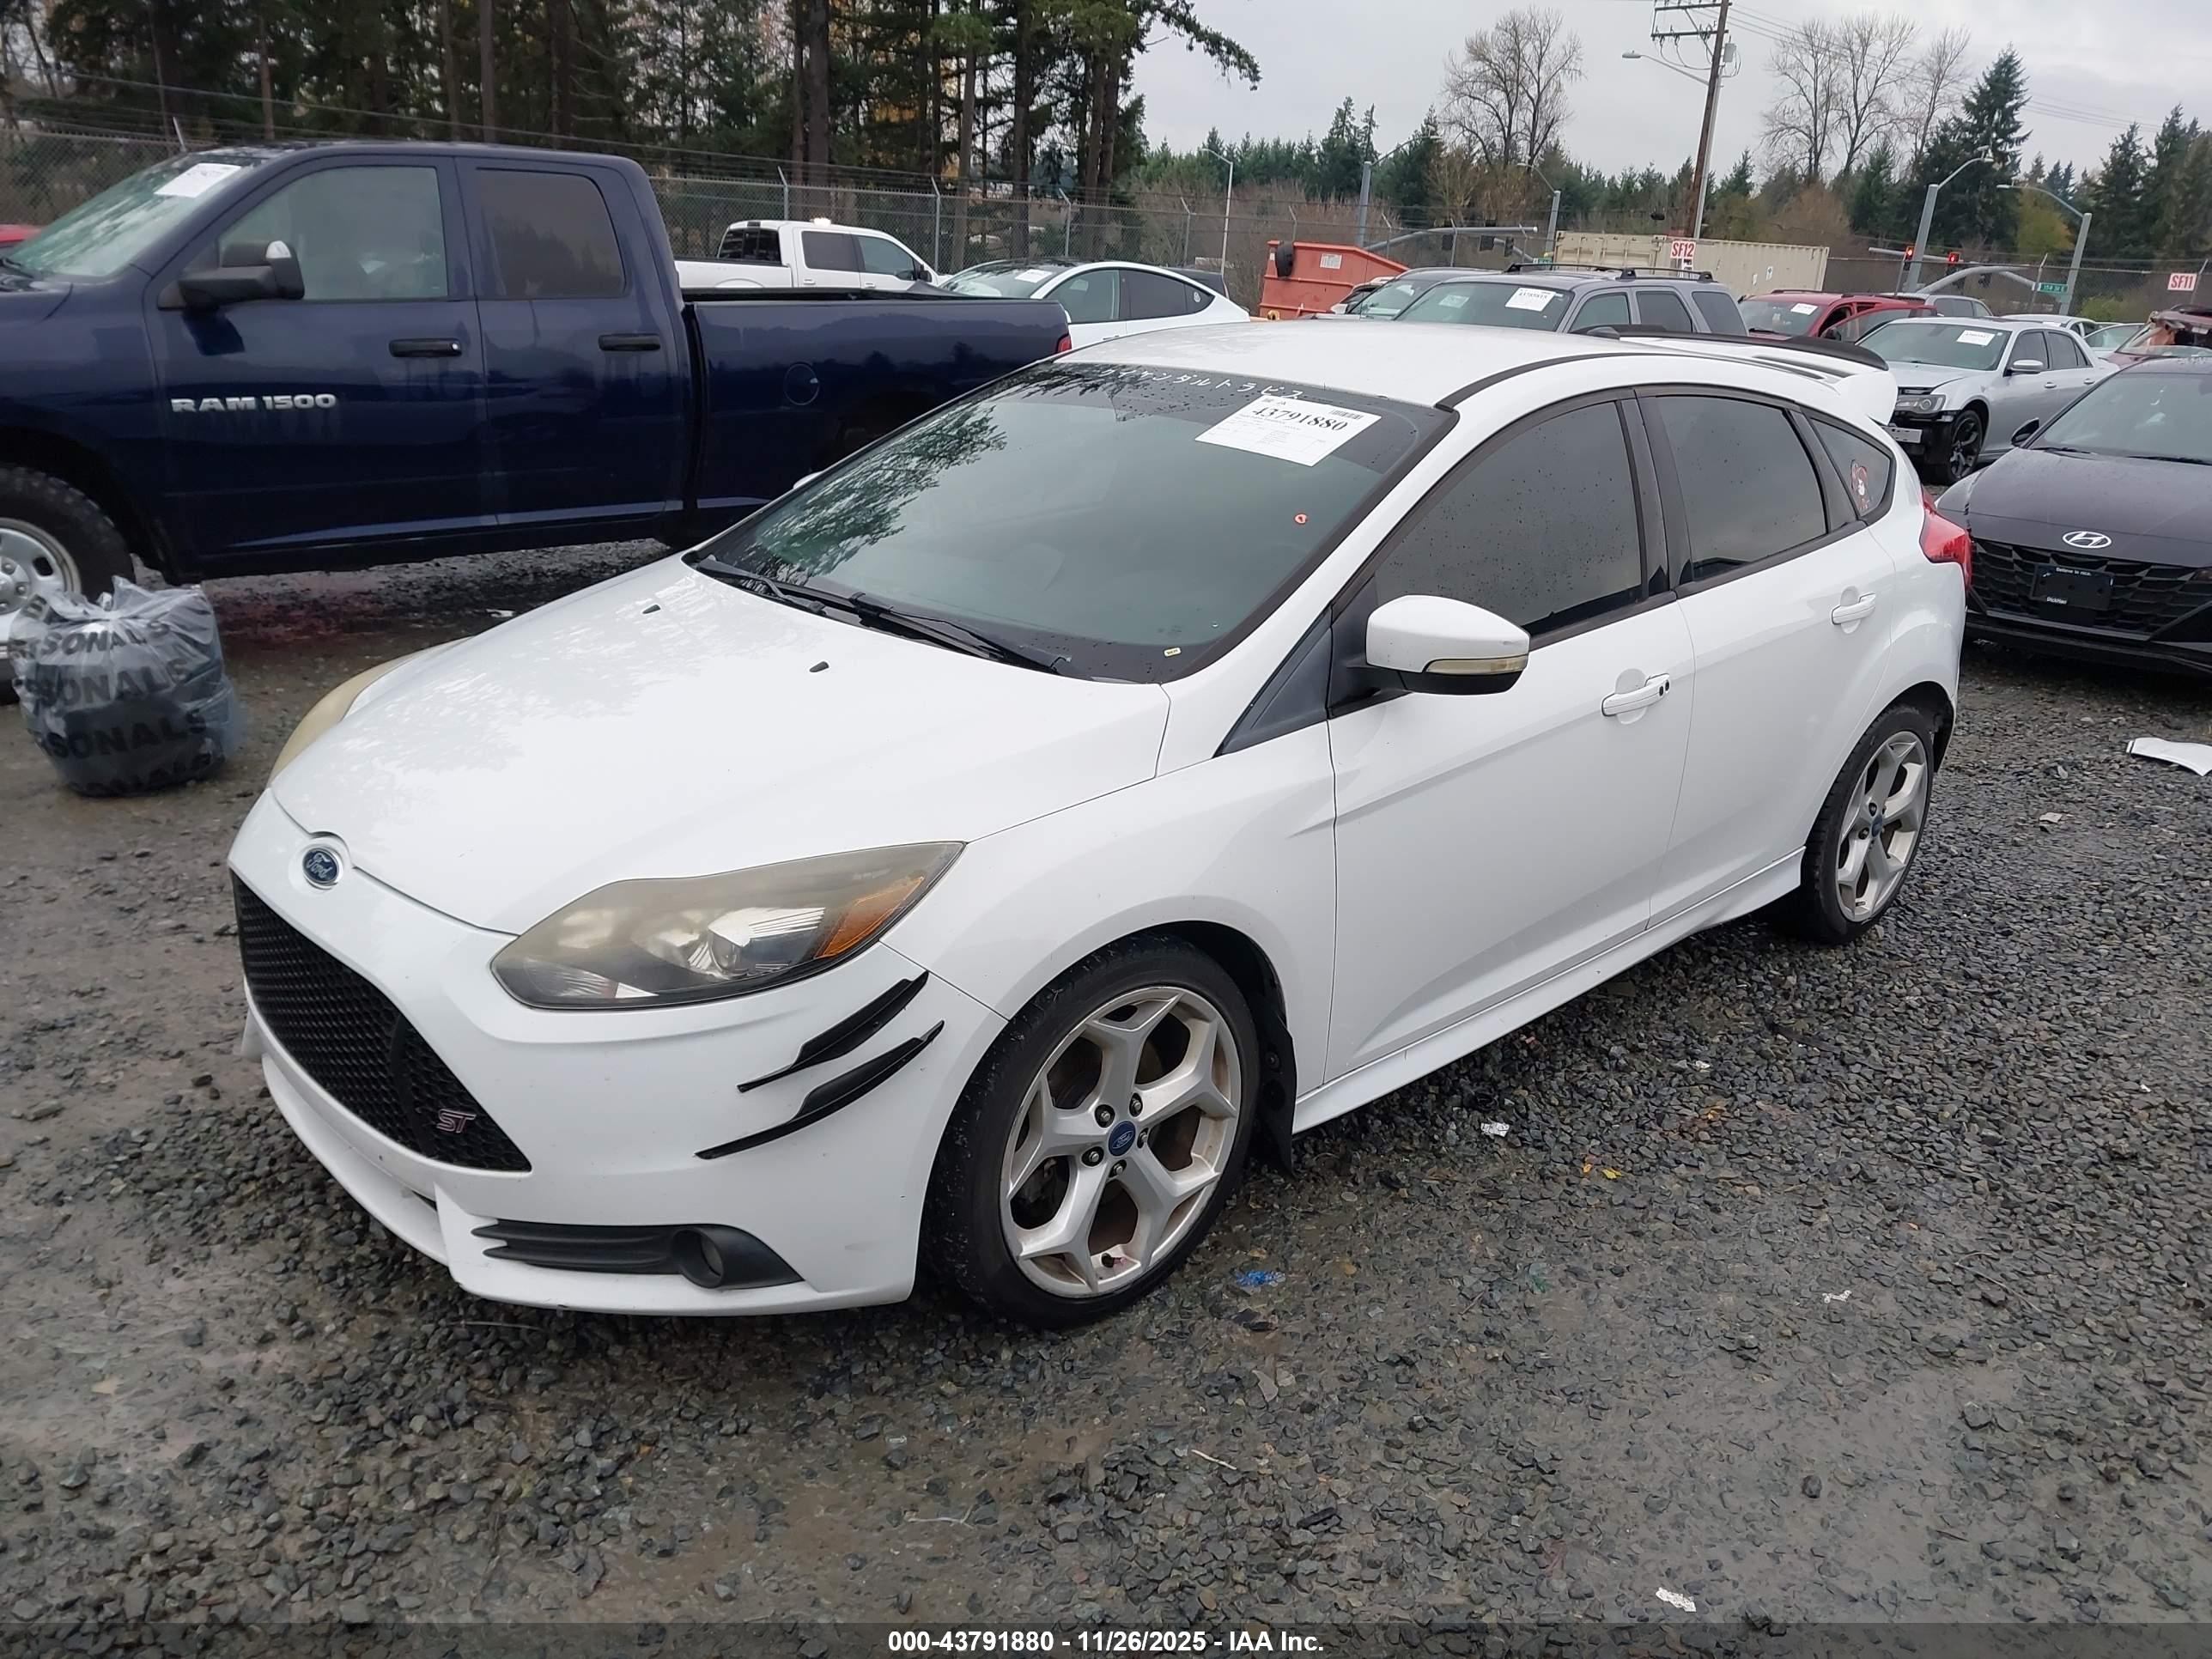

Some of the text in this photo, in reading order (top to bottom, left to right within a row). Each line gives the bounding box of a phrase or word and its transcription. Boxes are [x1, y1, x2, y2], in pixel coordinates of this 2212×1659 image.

[1671, 242, 1695, 258] SF12
[2170, 275, 2194, 289] SF11
[171, 393, 337, 412] RAM 1500
[1252, 406, 1349, 431] 43791880
[306, 852, 333, 878] Ford
[436, 1109, 476, 1133] ST
